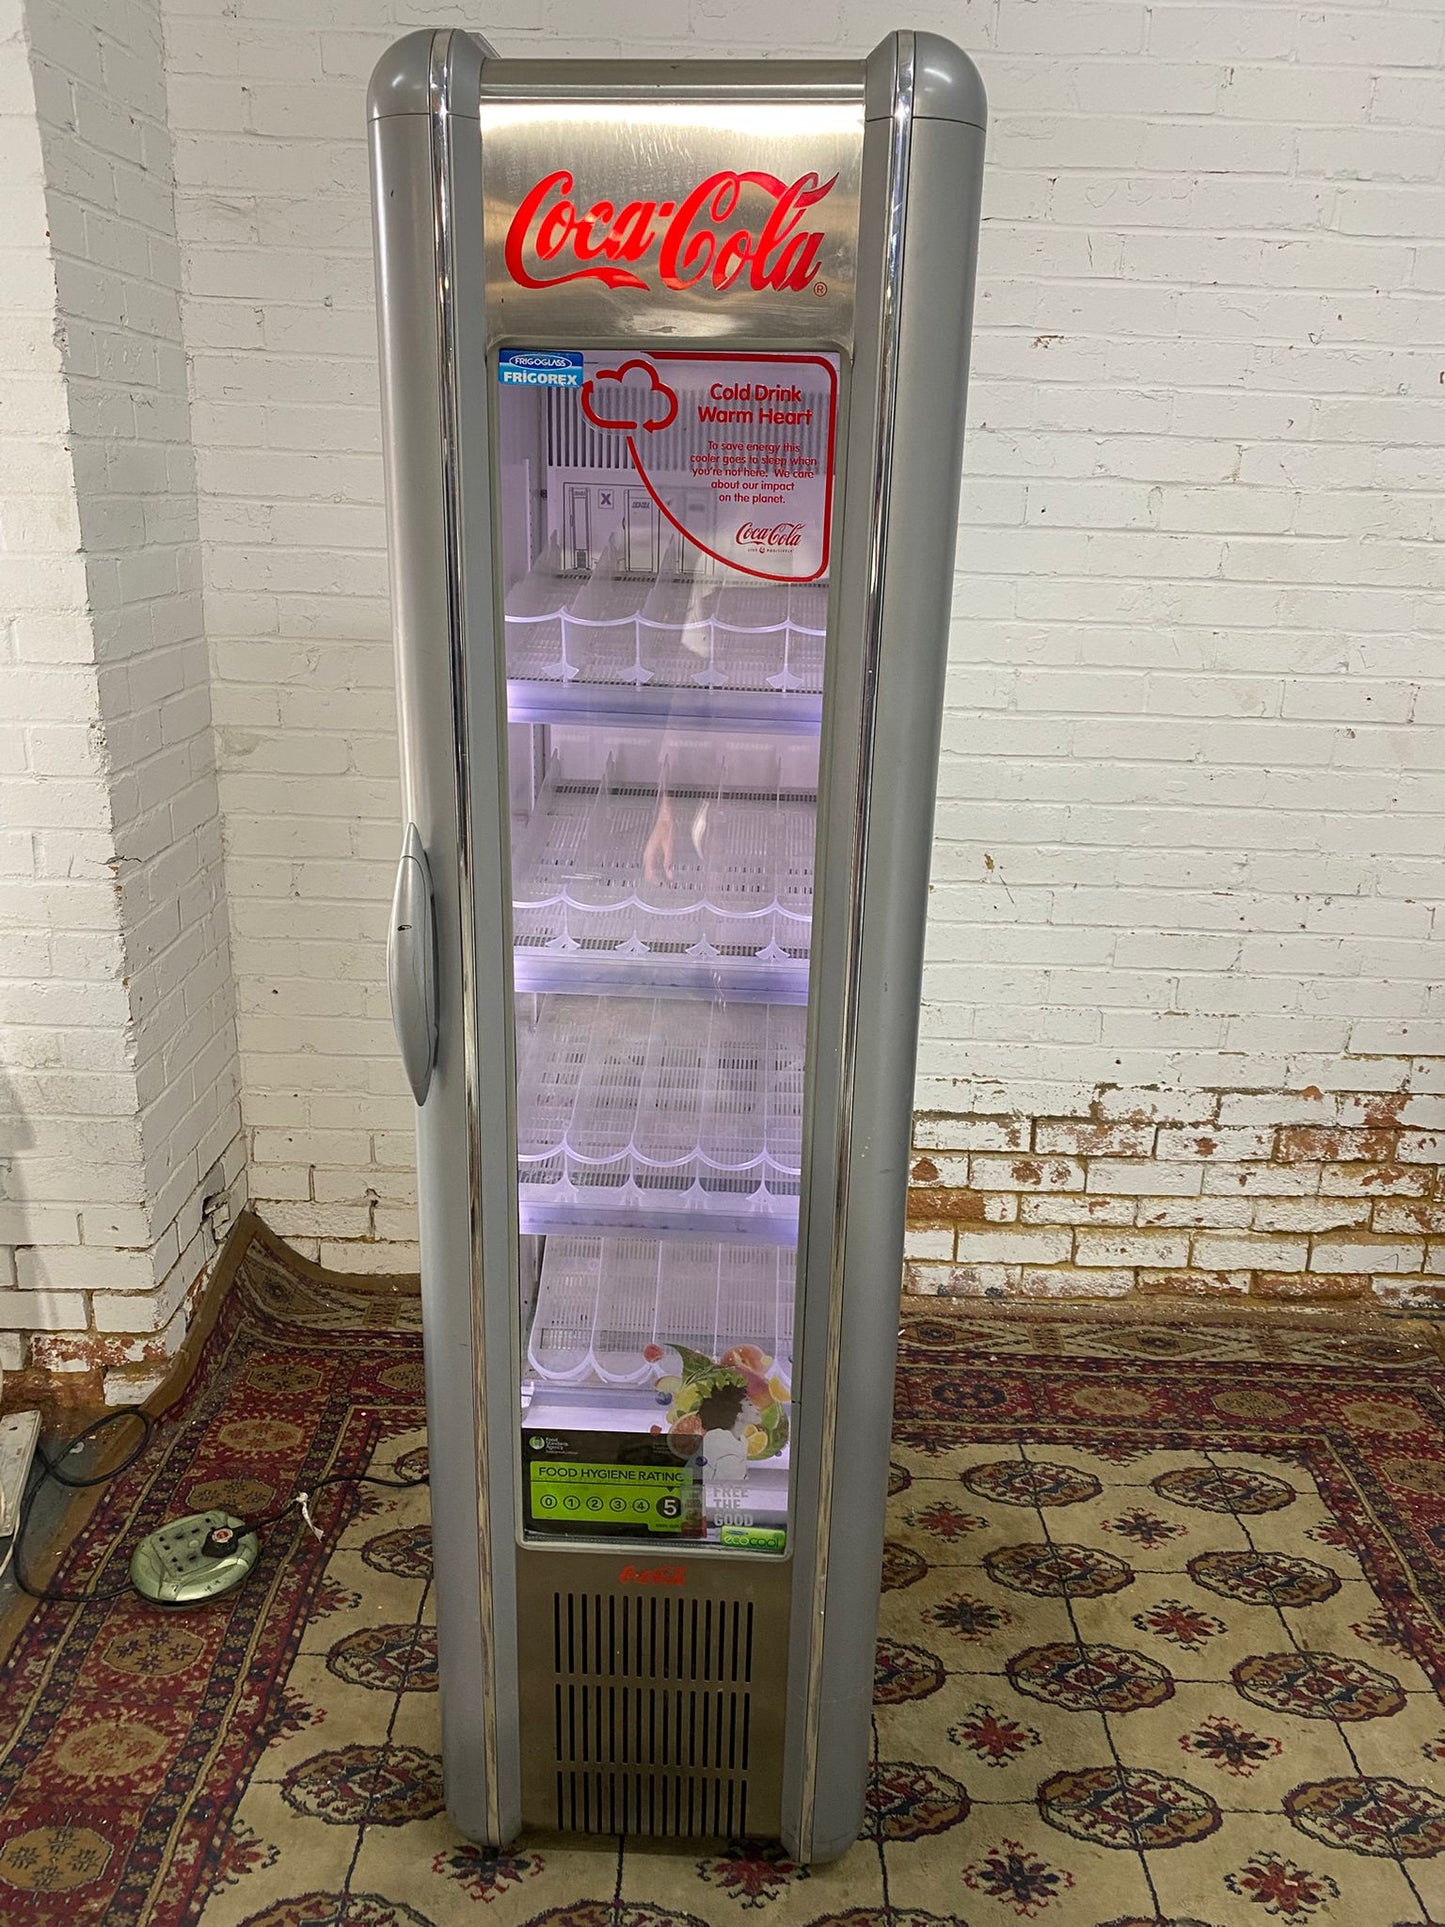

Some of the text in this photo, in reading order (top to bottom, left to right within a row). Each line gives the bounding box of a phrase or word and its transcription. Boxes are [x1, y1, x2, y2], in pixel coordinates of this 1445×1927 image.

[504, 170, 839, 291] Coca-Cola
[515, 357, 567, 367] FRIGOGLASS
[710, 383, 802, 402] Cold Drink
[698, 406, 812, 425] Warm Heart
[708, 440, 800, 454] To save energy this
[690, 454, 817, 467] cooler goes to sleep when
[725, 467, 740, 477] not
[743, 468, 768, 478] here.
[774, 469, 791, 479] We
[711, 479, 795, 493] about our impact
[719, 492, 786, 504] on the planet.
[736, 522, 805, 546] Coca-Cola
[538, 1467, 578, 1478] FOOD
[581, 1469, 636, 1482] HYGIENE
[713, 1487, 749, 1498] FREE
[663, 1499, 677, 1516] 5
[713, 1498, 741, 1510] THE
[713, 1512, 754, 1527] GOOD
